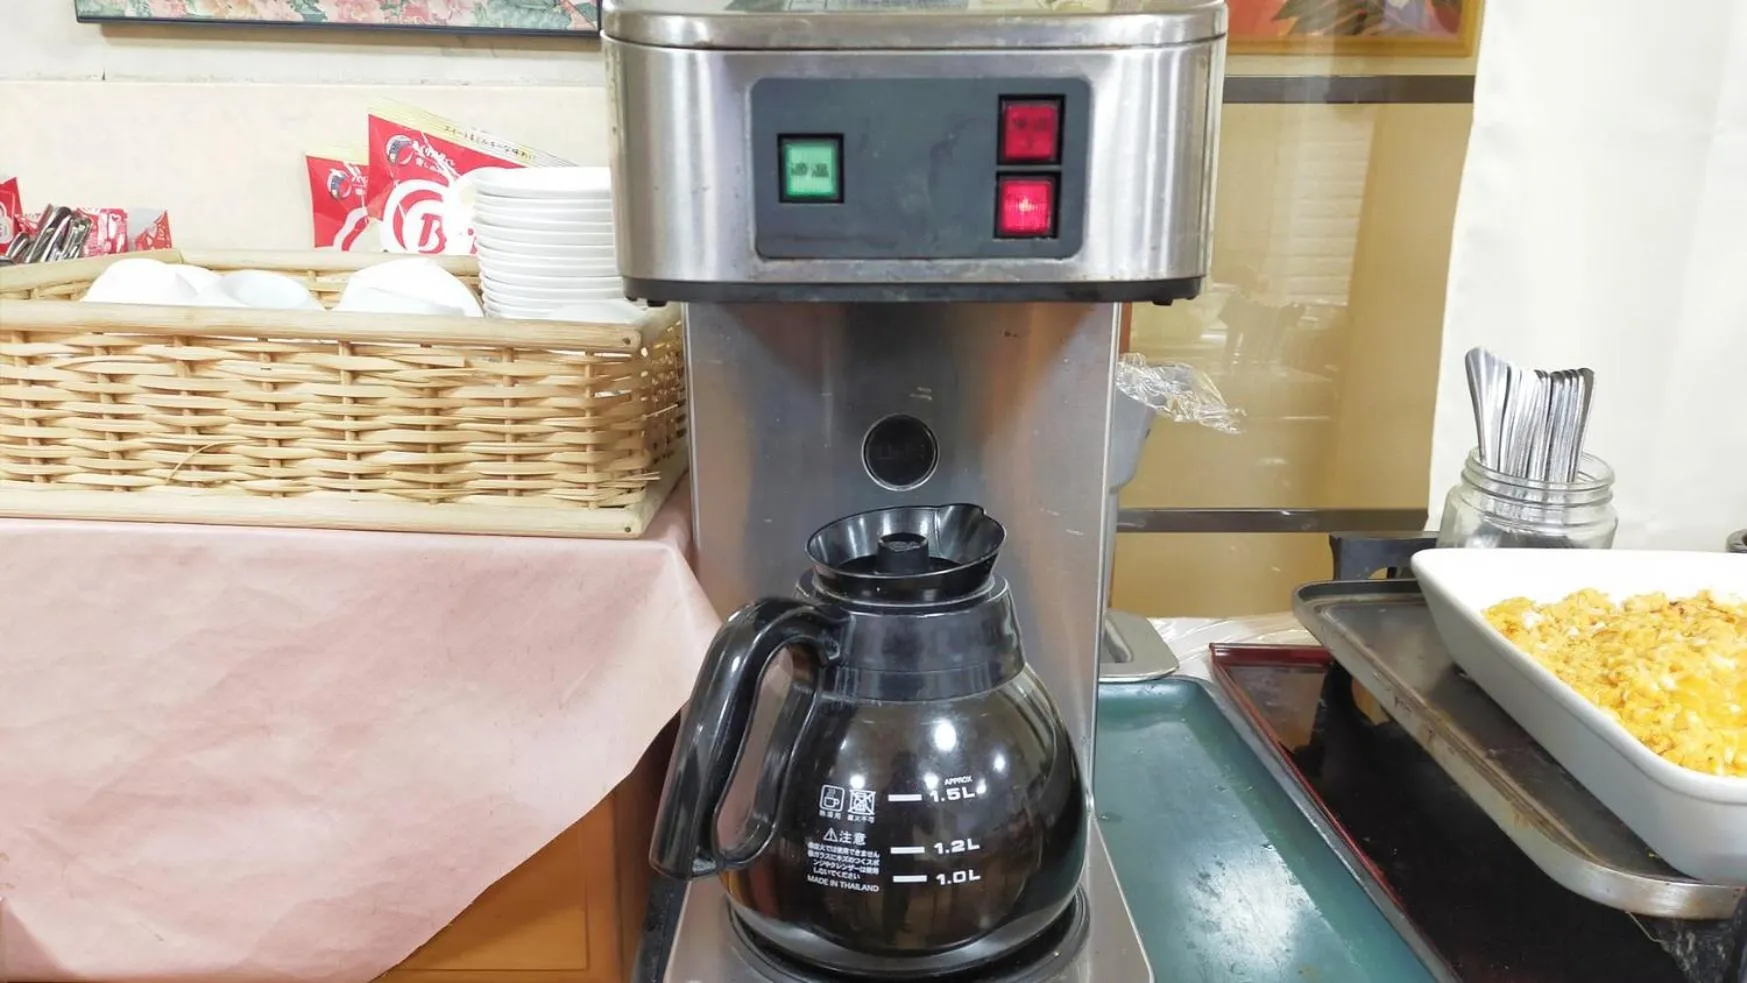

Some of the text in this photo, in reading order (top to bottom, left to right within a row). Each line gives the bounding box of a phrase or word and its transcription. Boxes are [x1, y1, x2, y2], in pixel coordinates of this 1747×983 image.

[944, 776, 973, 785] APPROX
[929, 786, 976, 802] 1.5L
[839, 830, 866, 845] 注意
[934, 838, 980, 854] 1.2L
[807, 874, 880, 892] MADE IN THAILAND
[936, 869, 981, 885] 1.0L
